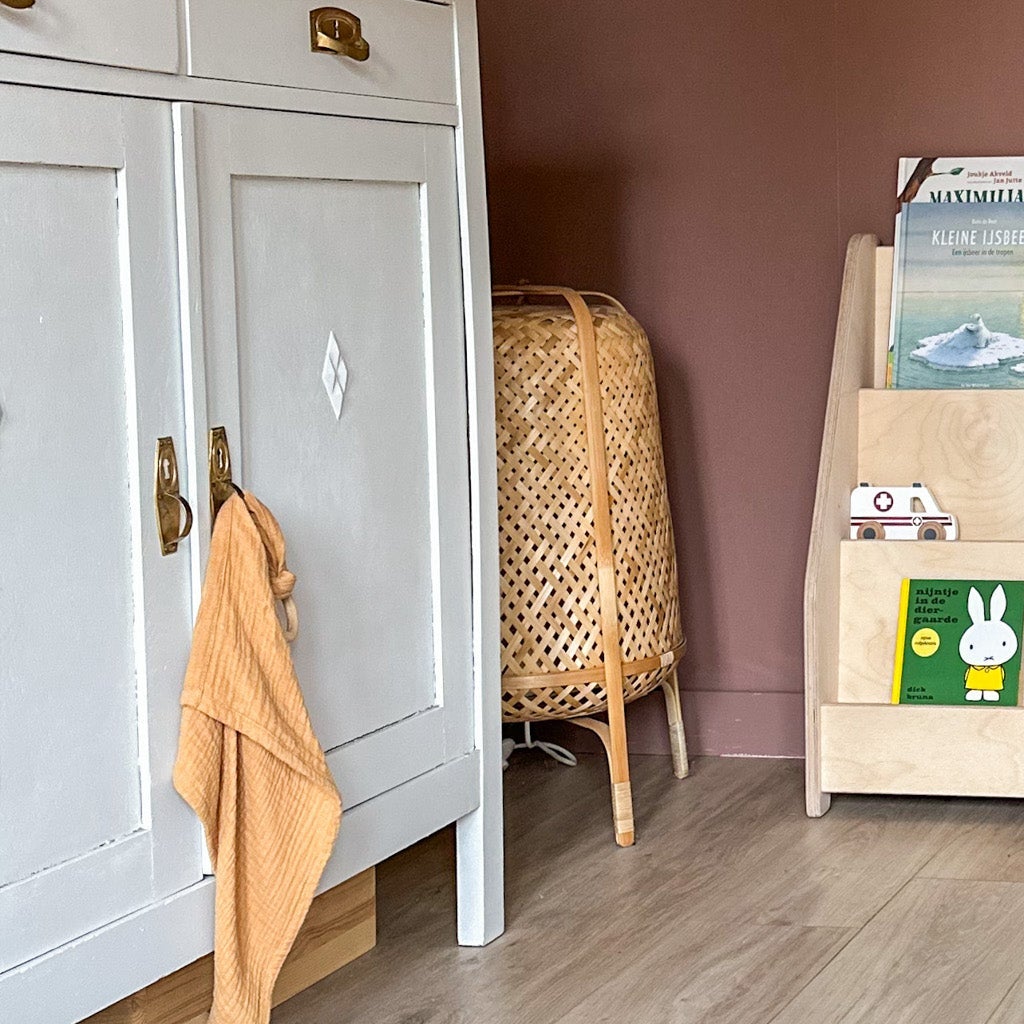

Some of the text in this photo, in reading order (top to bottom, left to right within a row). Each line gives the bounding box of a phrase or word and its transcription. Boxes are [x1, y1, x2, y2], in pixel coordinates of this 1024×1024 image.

[932, 229, 977, 246] KLEINE
[952, 248, 962, 256] Een
[916, 587, 959, 596] nijntje
[915, 597, 945, 605] in de
[914, 606, 943, 614] dier-
[913, 616, 958, 624] gaarde
